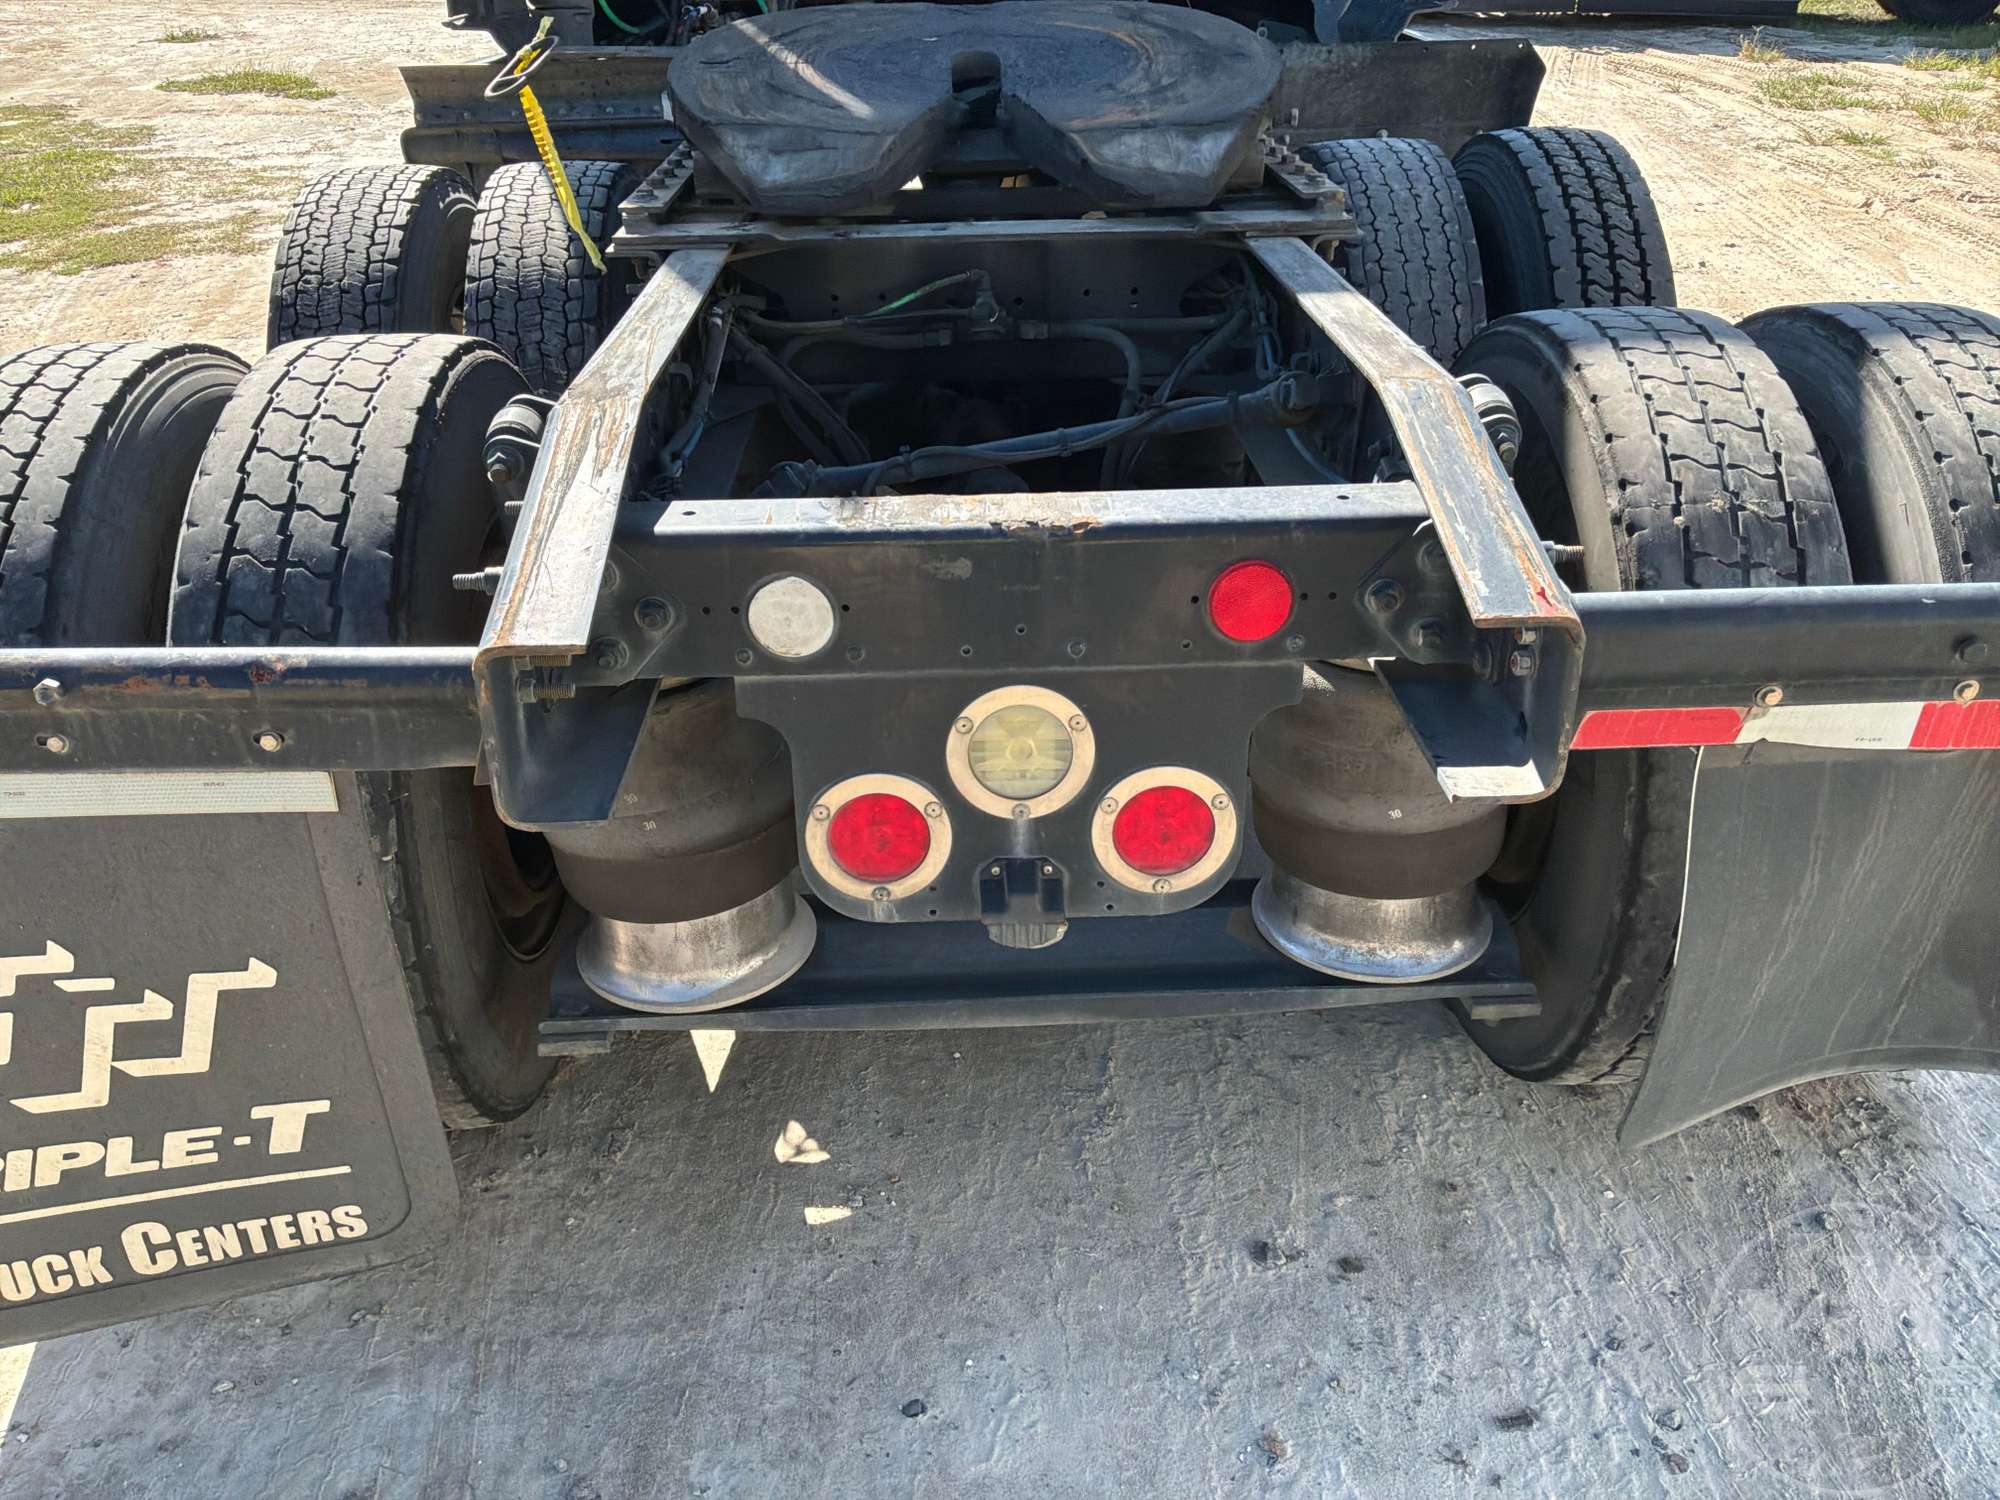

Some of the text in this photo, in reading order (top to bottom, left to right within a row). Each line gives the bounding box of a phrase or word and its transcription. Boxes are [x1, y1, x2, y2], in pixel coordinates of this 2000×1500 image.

[1387, 808, 1402, 820] 30
[642, 820, 657, 832] 30
[0, 1100, 331, 1192] IPLE-T
